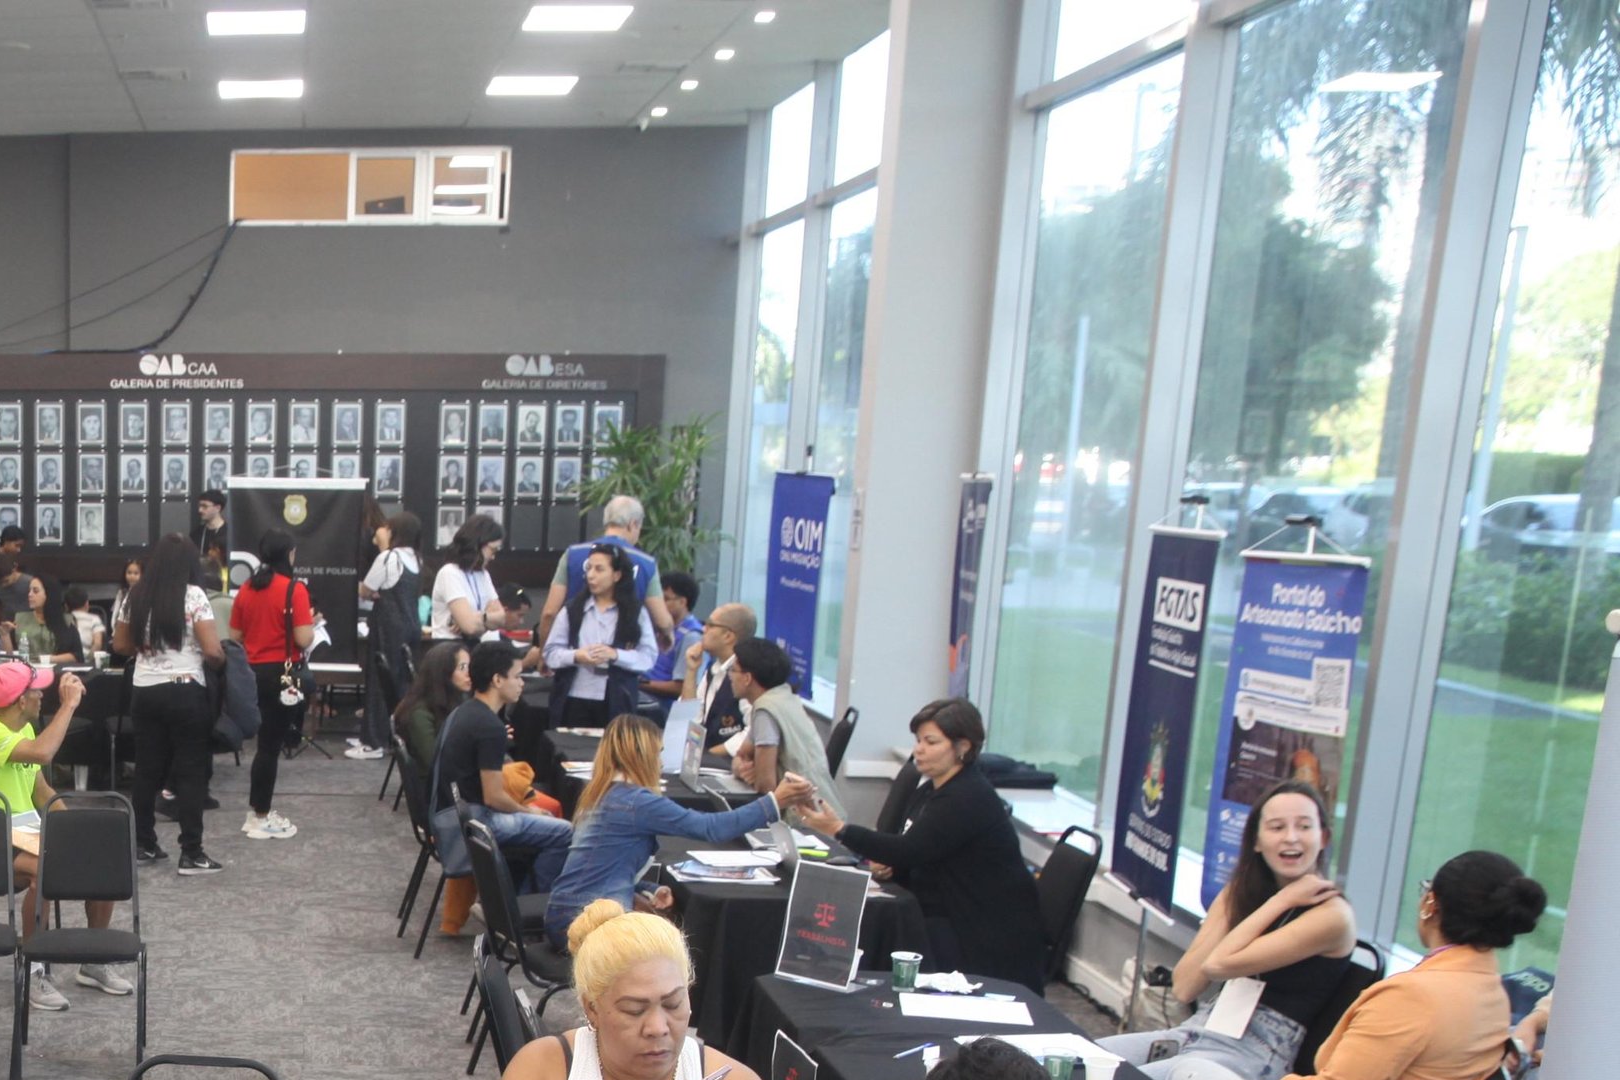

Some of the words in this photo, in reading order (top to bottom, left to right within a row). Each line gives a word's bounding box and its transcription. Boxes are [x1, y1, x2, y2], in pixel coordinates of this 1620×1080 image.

[188, 362, 218, 375] CAA
[555, 363, 584, 376] ESA
[110, 379, 154, 389] GALERIA
[156, 379, 170, 389] DE
[172, 379, 244, 389] PRESIDENTES
[481, 380, 527, 390] GALERIA
[529, 381, 543, 390] DE
[546, 381, 607, 390] DIRETORES
[795, 518, 823, 552] OIM
[293, 567, 312, 575] ACIA
[326, 566, 357, 575] POLÍCIA
[1272, 583, 1308, 607] Portal
[1309, 585, 1326, 608] do
[1157, 585, 1200, 622] FGTAS
[1239, 603, 1304, 629] Artesanato
[1305, 608, 1362, 634] Gaúcho
